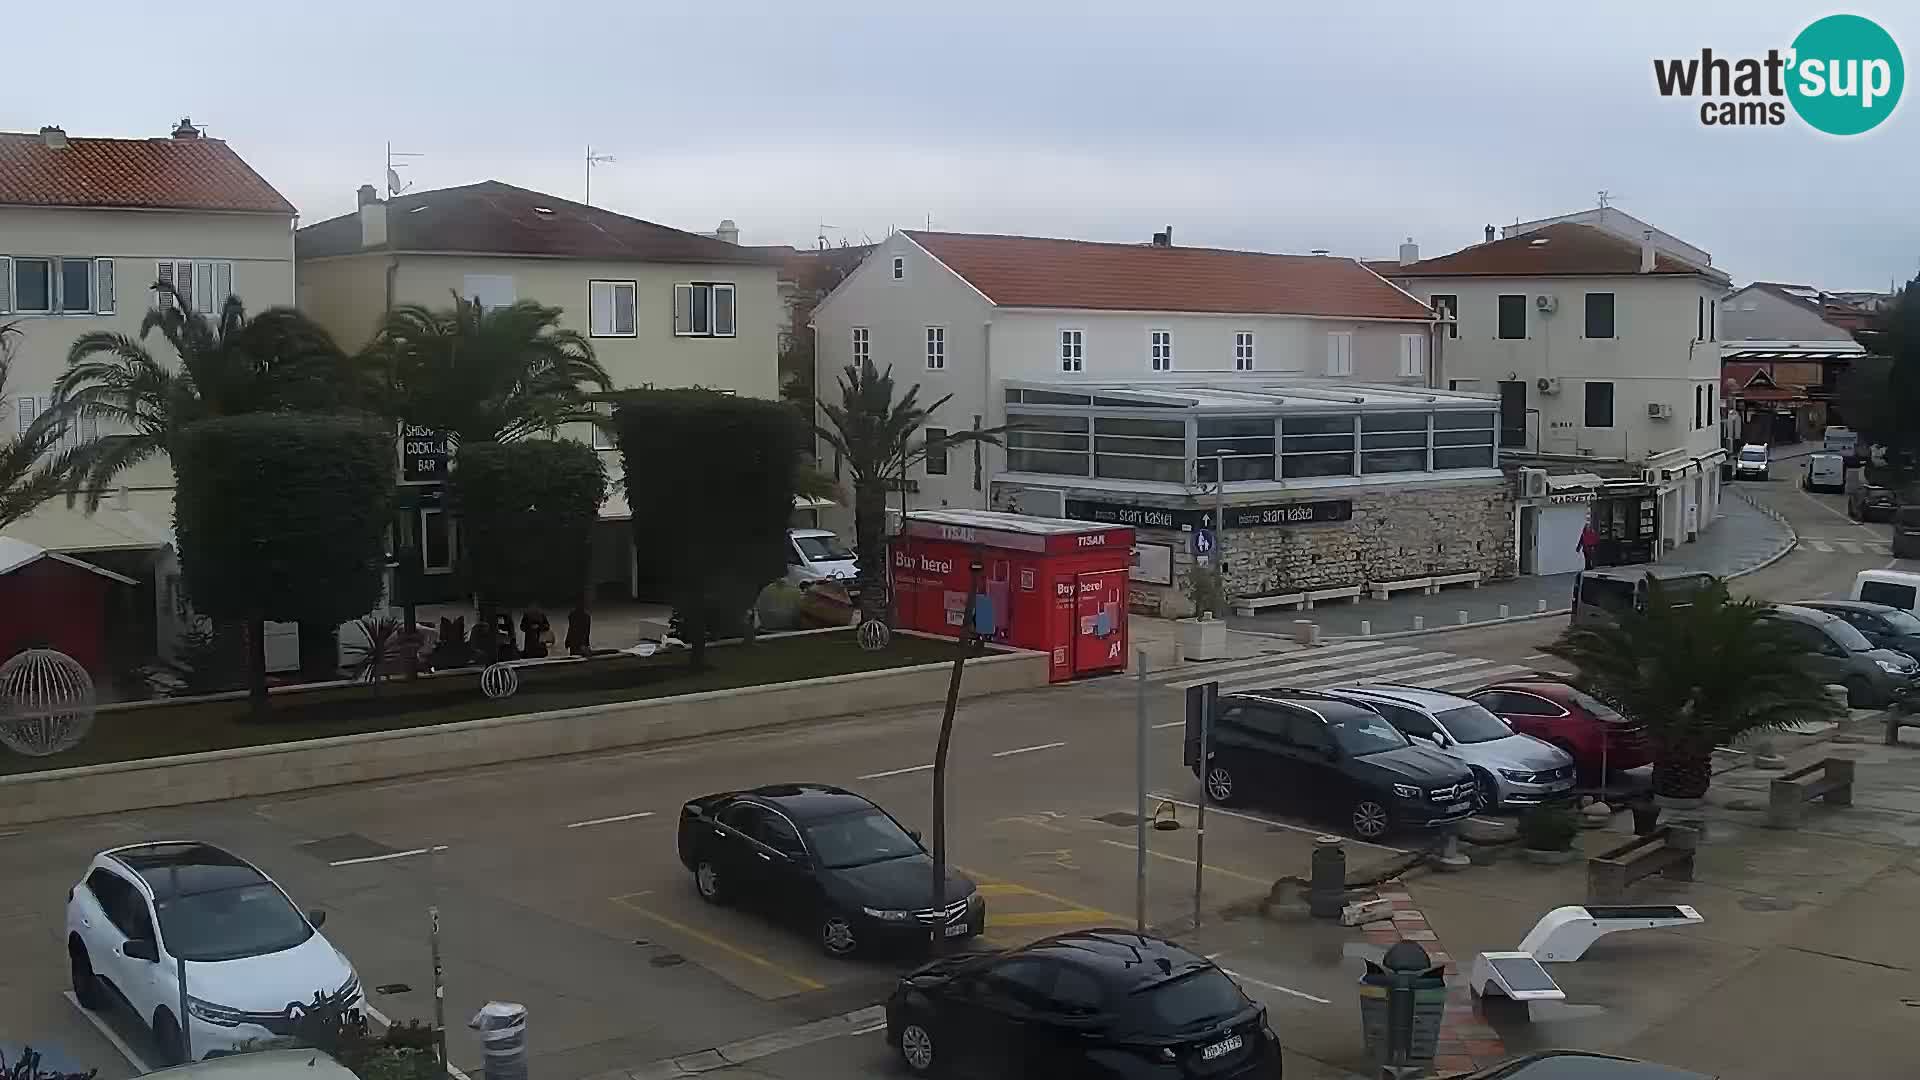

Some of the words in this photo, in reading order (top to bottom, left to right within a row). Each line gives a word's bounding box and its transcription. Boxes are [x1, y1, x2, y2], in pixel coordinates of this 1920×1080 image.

[418, 459, 436, 471] BAR
[895, 551, 916, 569] Buy
[921, 554, 952, 573] here!
[1057, 583, 1075, 595] Buy
[1080, 579, 1103, 592] here!
